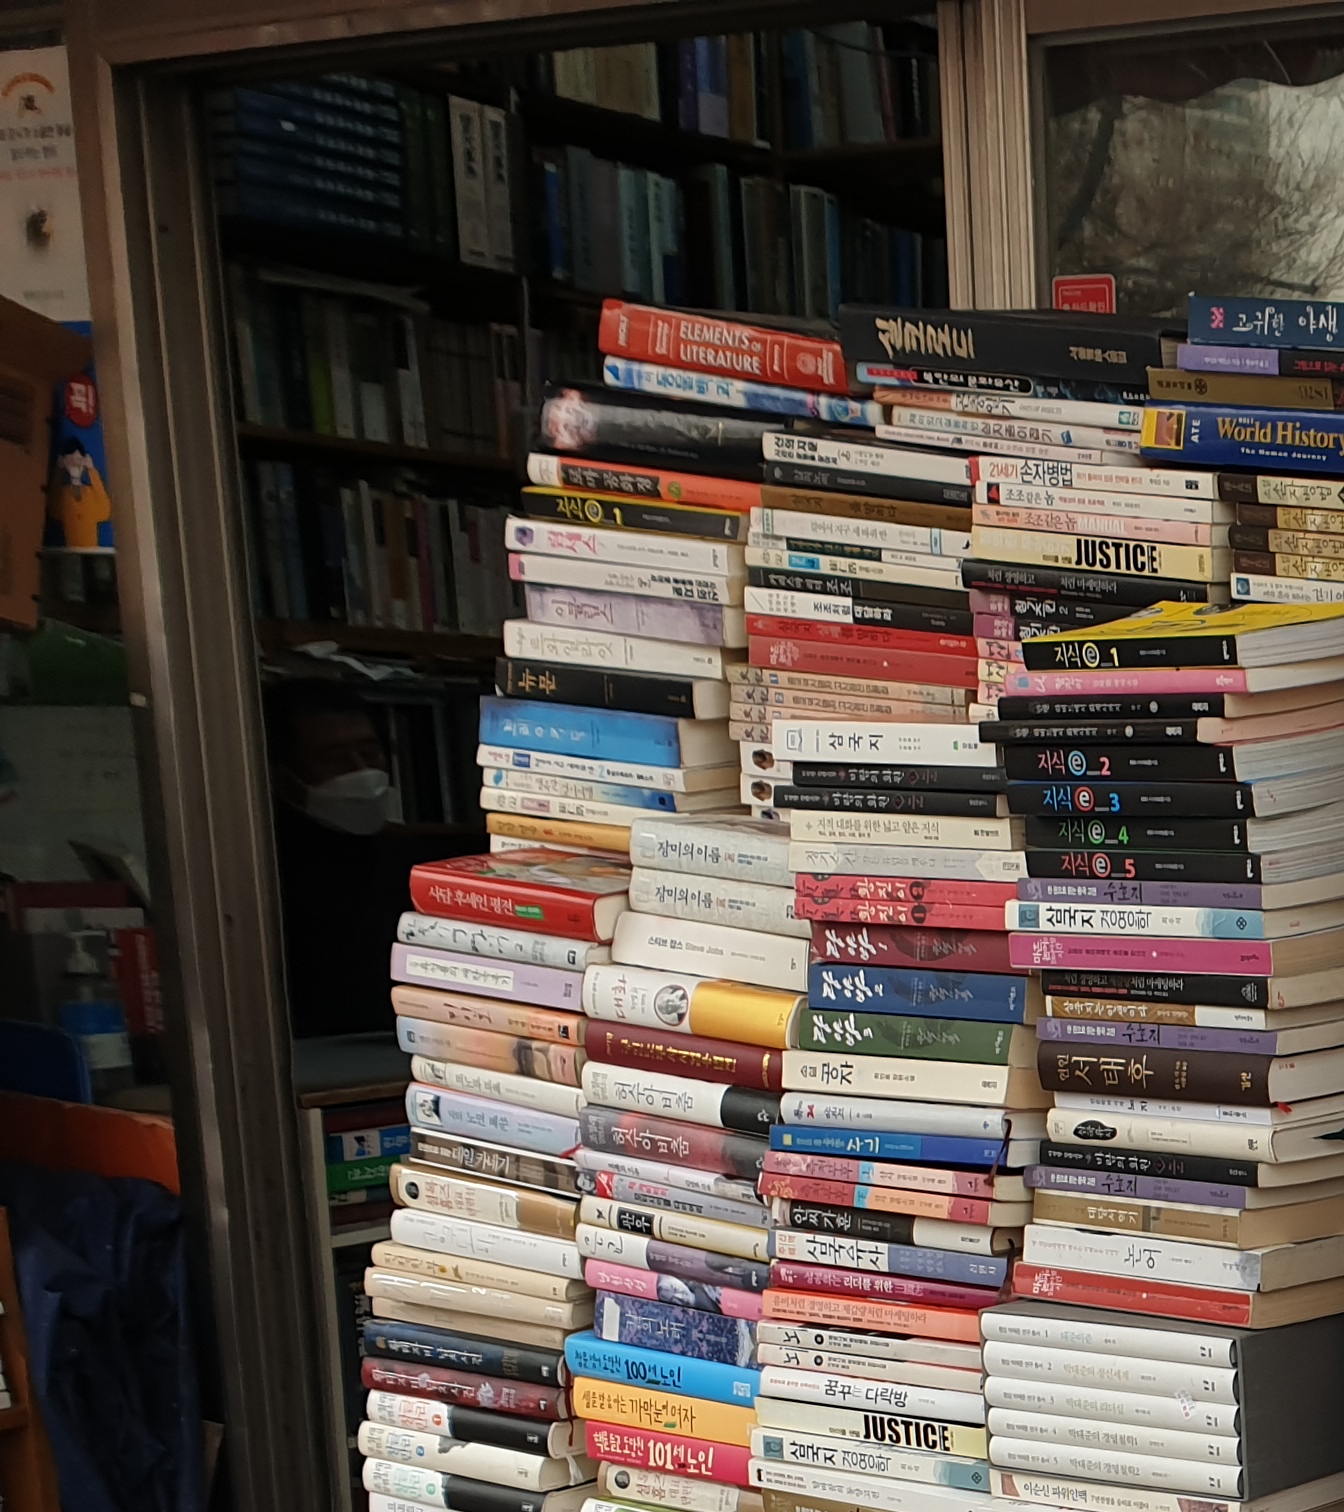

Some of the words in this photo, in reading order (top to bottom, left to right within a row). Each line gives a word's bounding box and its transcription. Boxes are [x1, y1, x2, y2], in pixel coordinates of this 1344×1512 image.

[680, 322, 749, 351] ELEMENTS
[680, 342, 761, 374] LITERATURE
[1216, 417, 1272, 444] World
[1075, 539, 1158, 573] JUSTICE
[824, 1379, 861, 1401] 꿈꾸는
[865, 1384, 908, 1408] 다락방
[863, 1414, 949, 1451] JUSTICE
[790, 1440, 837, 1465] 삼국지
[842, 1450, 891, 1473] 경영학
